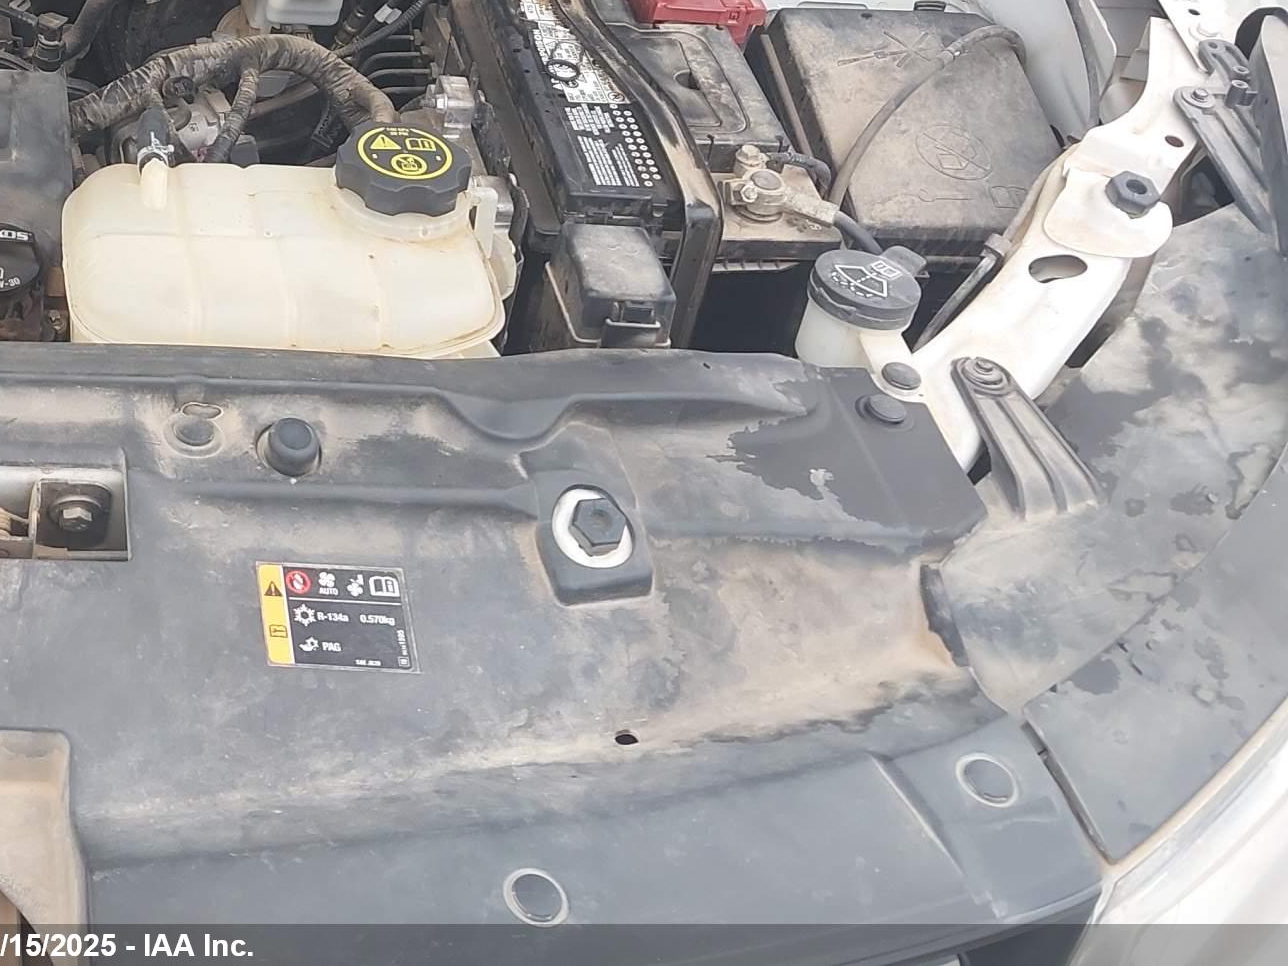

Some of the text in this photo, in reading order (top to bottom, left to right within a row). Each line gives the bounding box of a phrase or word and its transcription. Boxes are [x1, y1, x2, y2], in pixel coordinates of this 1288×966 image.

[319, 587, 339, 596] AUTO
[316, 611, 395, 626] R-134a 0.570kg
[321, 641, 342, 652] PAG
